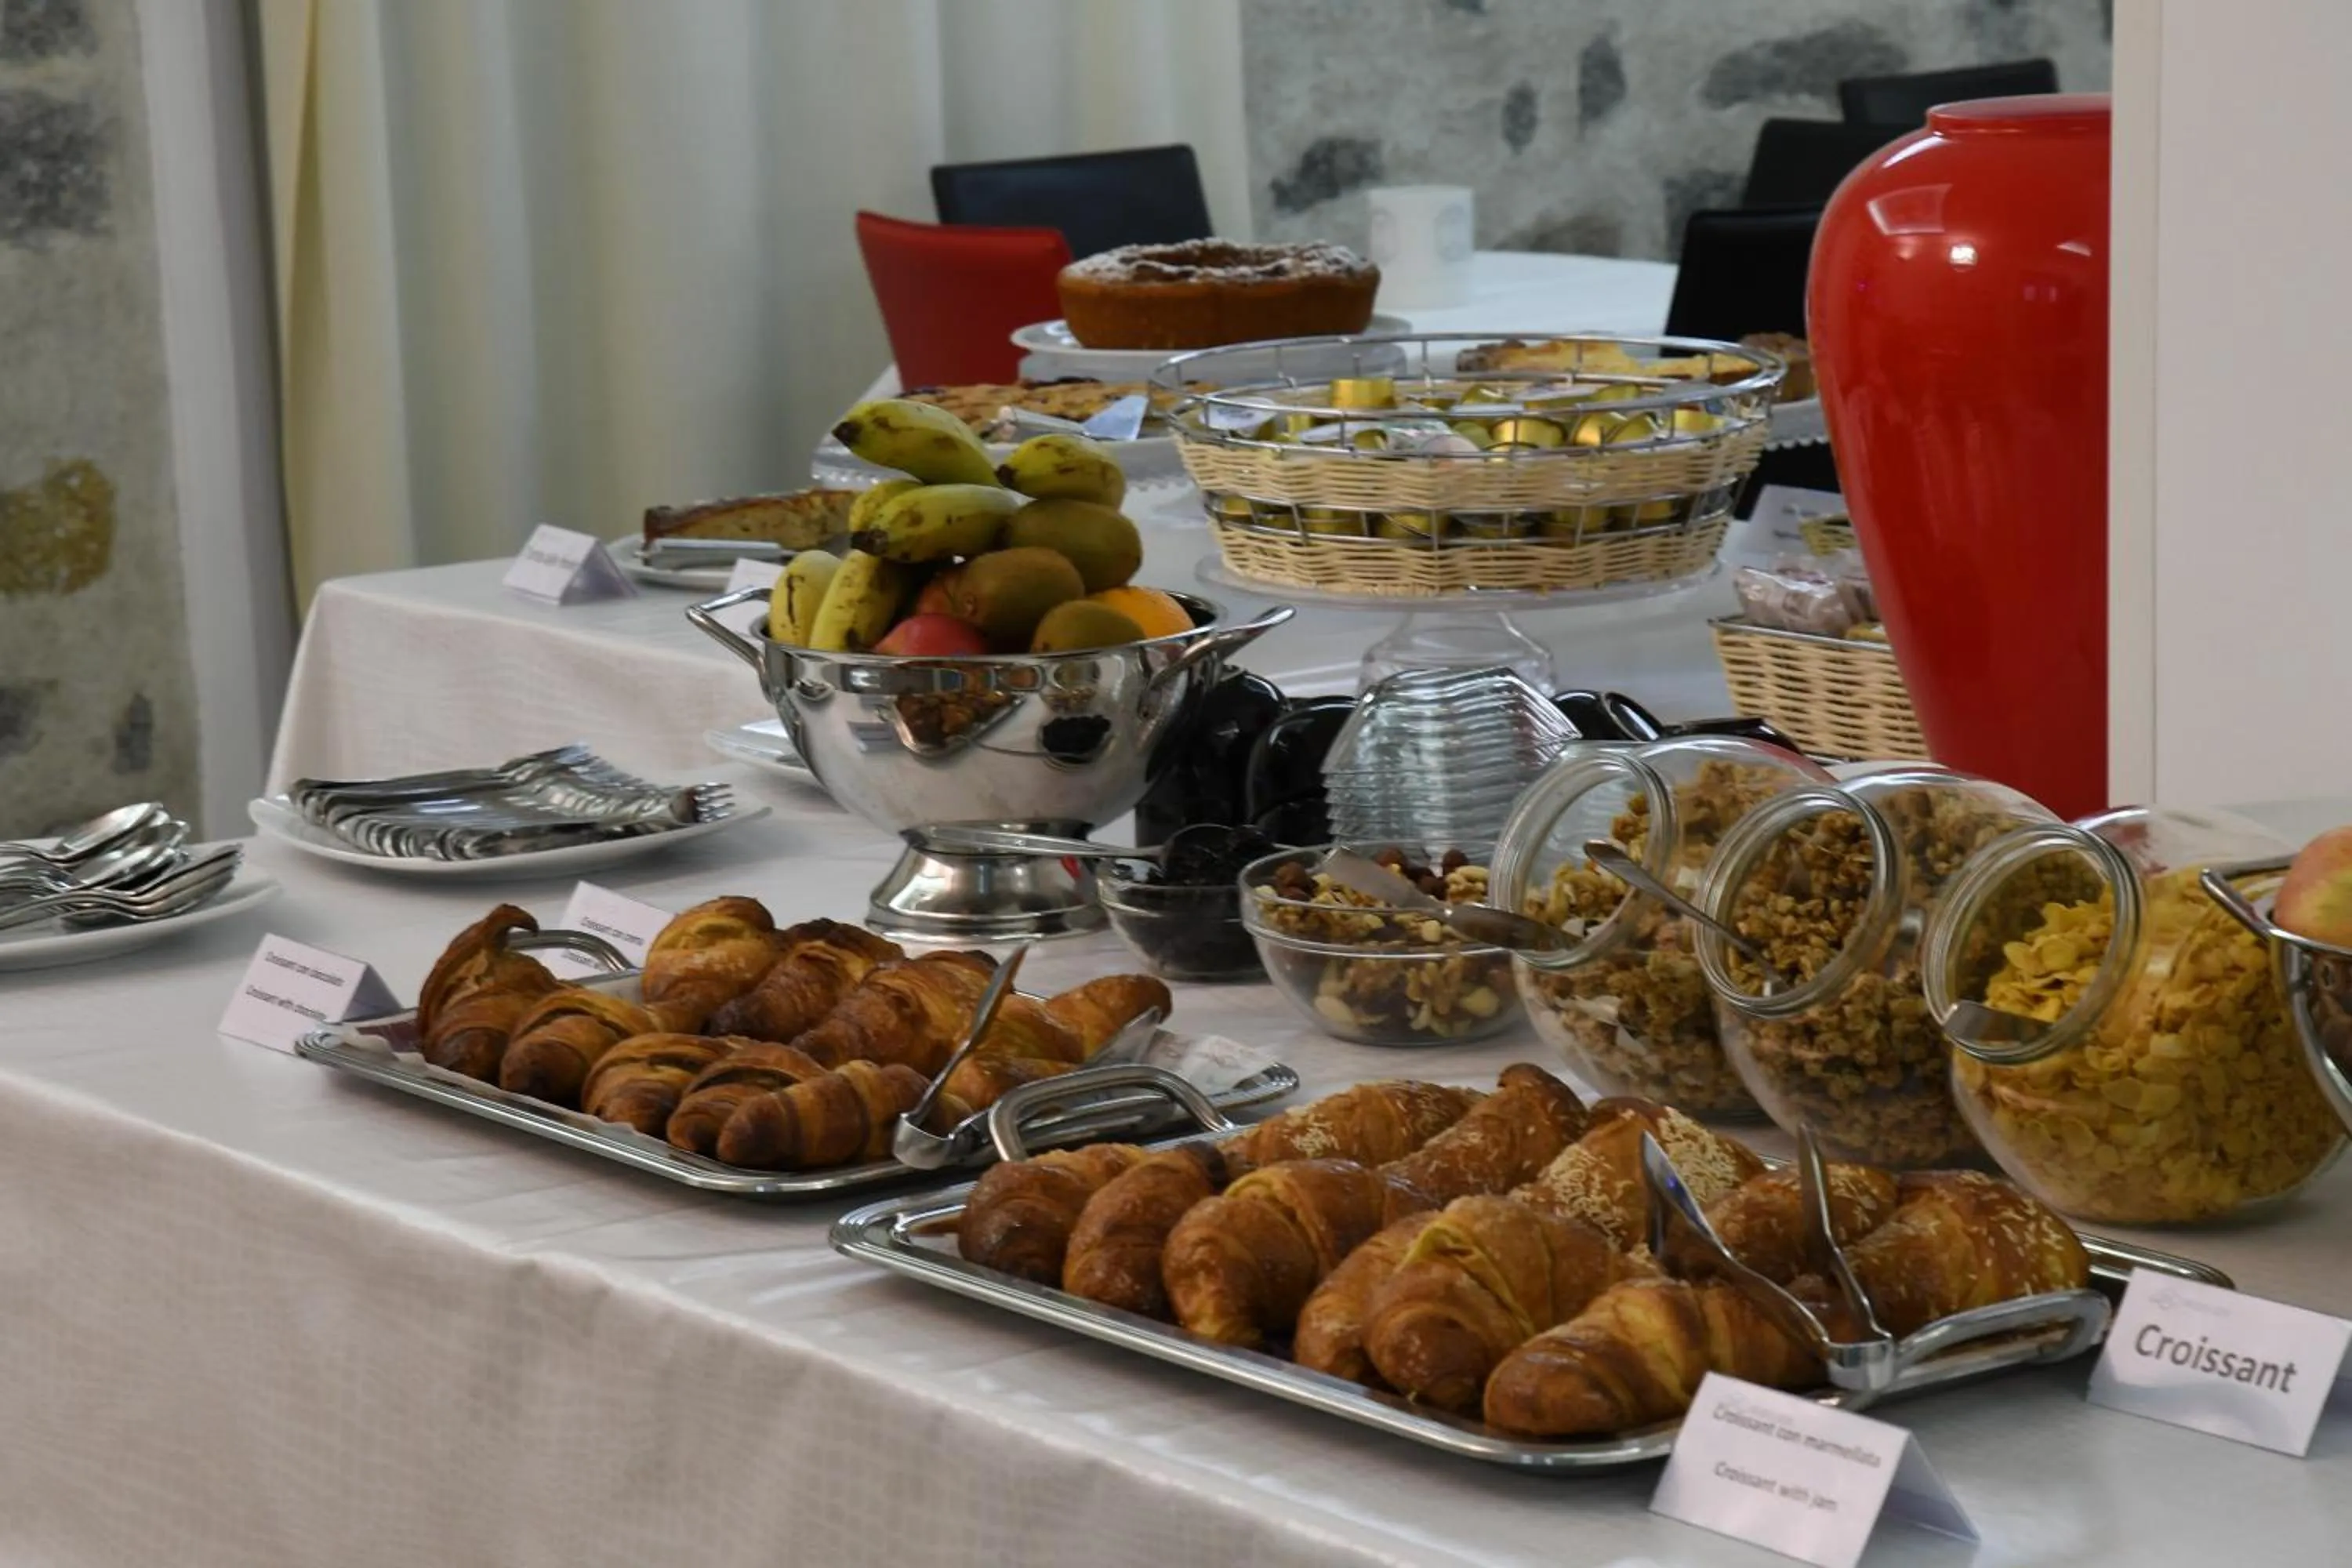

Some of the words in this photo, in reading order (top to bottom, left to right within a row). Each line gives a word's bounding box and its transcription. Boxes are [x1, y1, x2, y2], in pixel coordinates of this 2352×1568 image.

[2134, 1323, 2297, 1393] Croissant
[1714, 1403, 1777, 1436] Croissant
[1777, 1426, 1802, 1443] con
[1715, 1461, 1777, 1493] Croissant
[1779, 1484, 1809, 1503] with
[1809, 1494, 1838, 1512] jam
